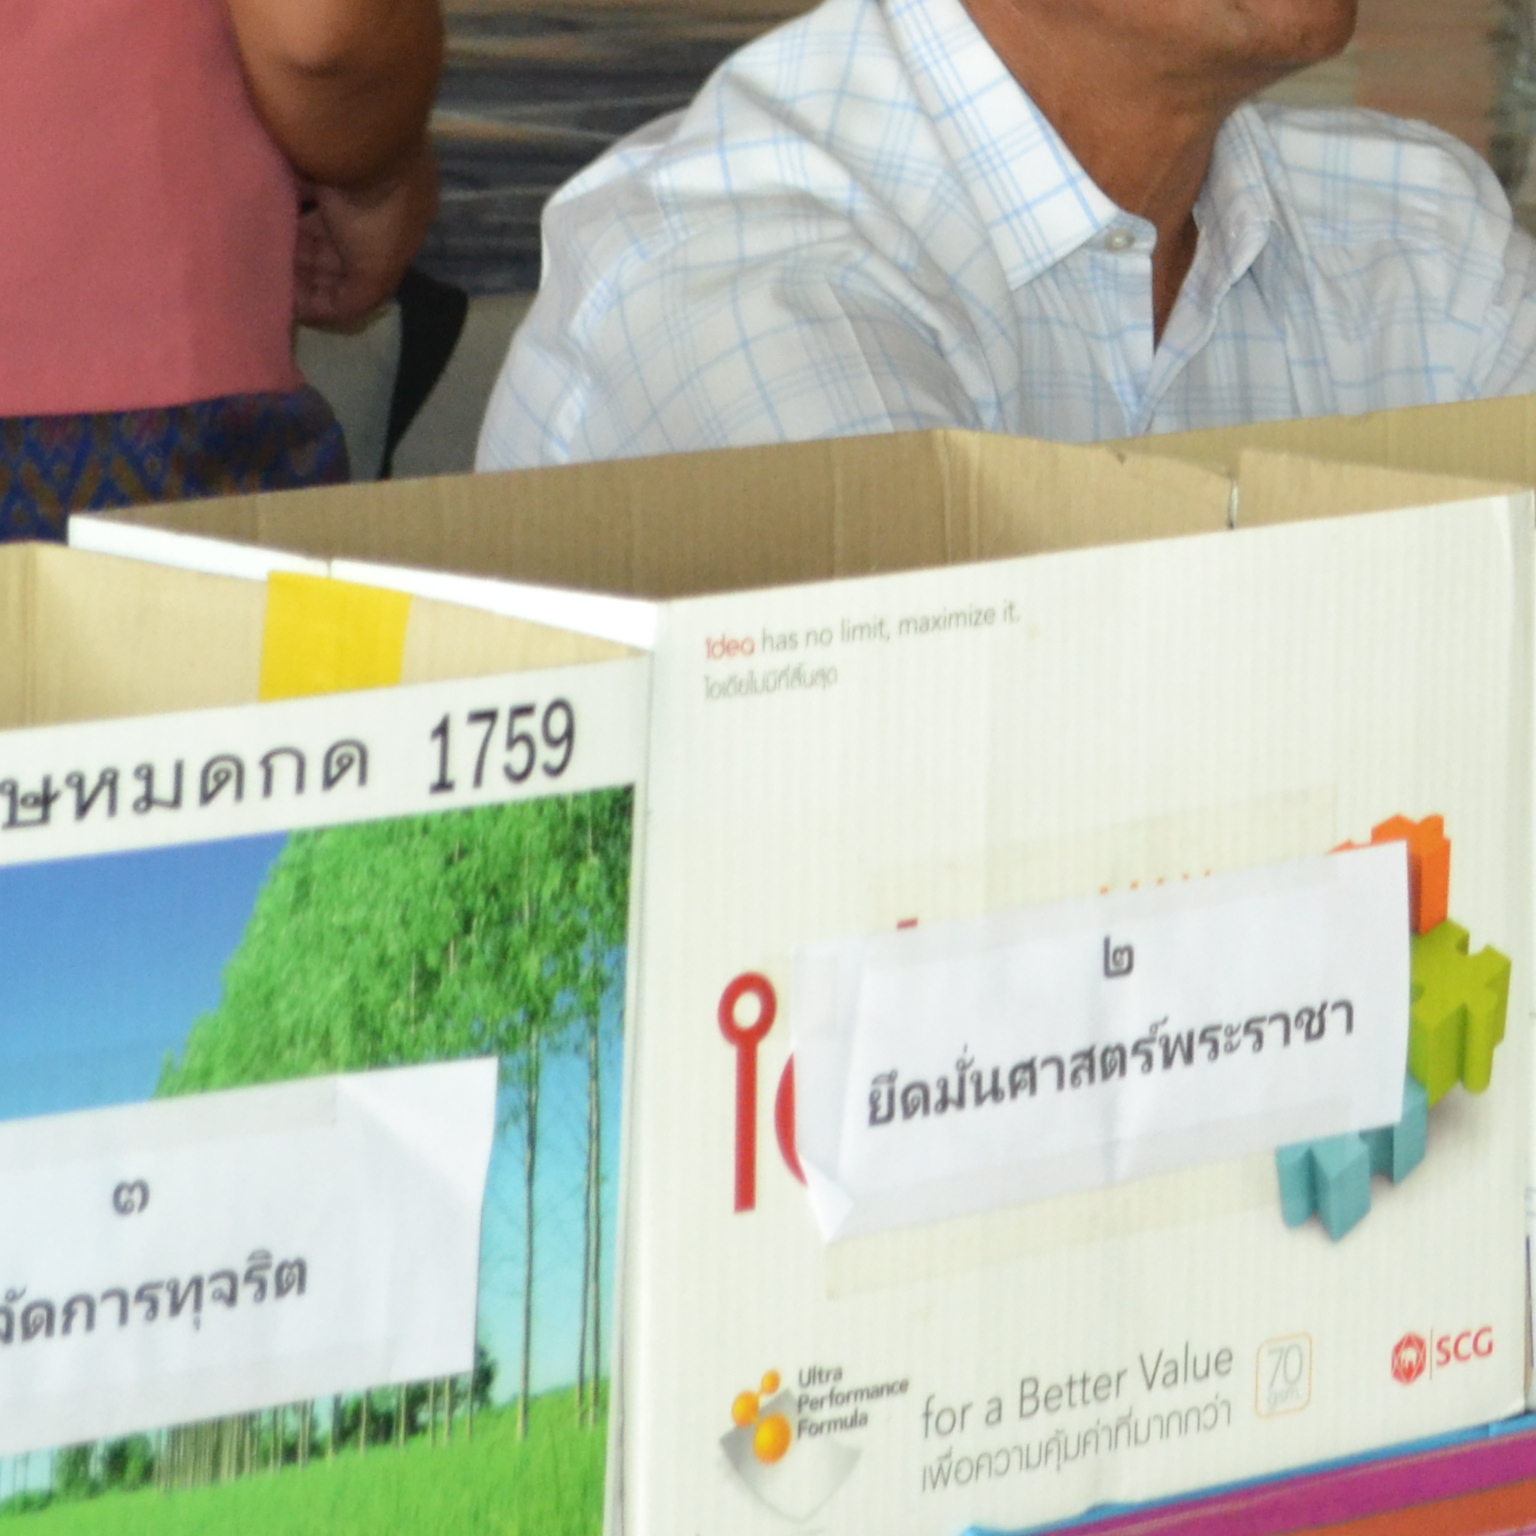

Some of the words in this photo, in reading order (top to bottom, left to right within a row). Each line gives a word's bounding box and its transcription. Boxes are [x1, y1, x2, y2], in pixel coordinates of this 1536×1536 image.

[761, 628, 799, 653] has
[805, 627, 834, 648] no
[840, 617, 891, 645] limit,
[898, 604, 996, 636] maximize
[430, 698, 577, 796] 1759
[1103, 936, 1134, 979] ๒
[867, 998, 1355, 1127] ยึดมั่นศาสตร์พระราชา
[112, 1178, 150, 1216] ๓
[1267, 1342, 1304, 1389] 70
[1436, 1326, 1494, 1366] SCG
[796, 1377, 909, 1415] Performance
[798, 1366, 843, 1388] Ultra
[922, 1394, 973, 1439] for
[985, 1396, 1003, 1426] a
[1018, 1368, 1128, 1419] Better
[1138, 1341, 1233, 1391] Value
[796, 1407, 868, 1439] Formula
